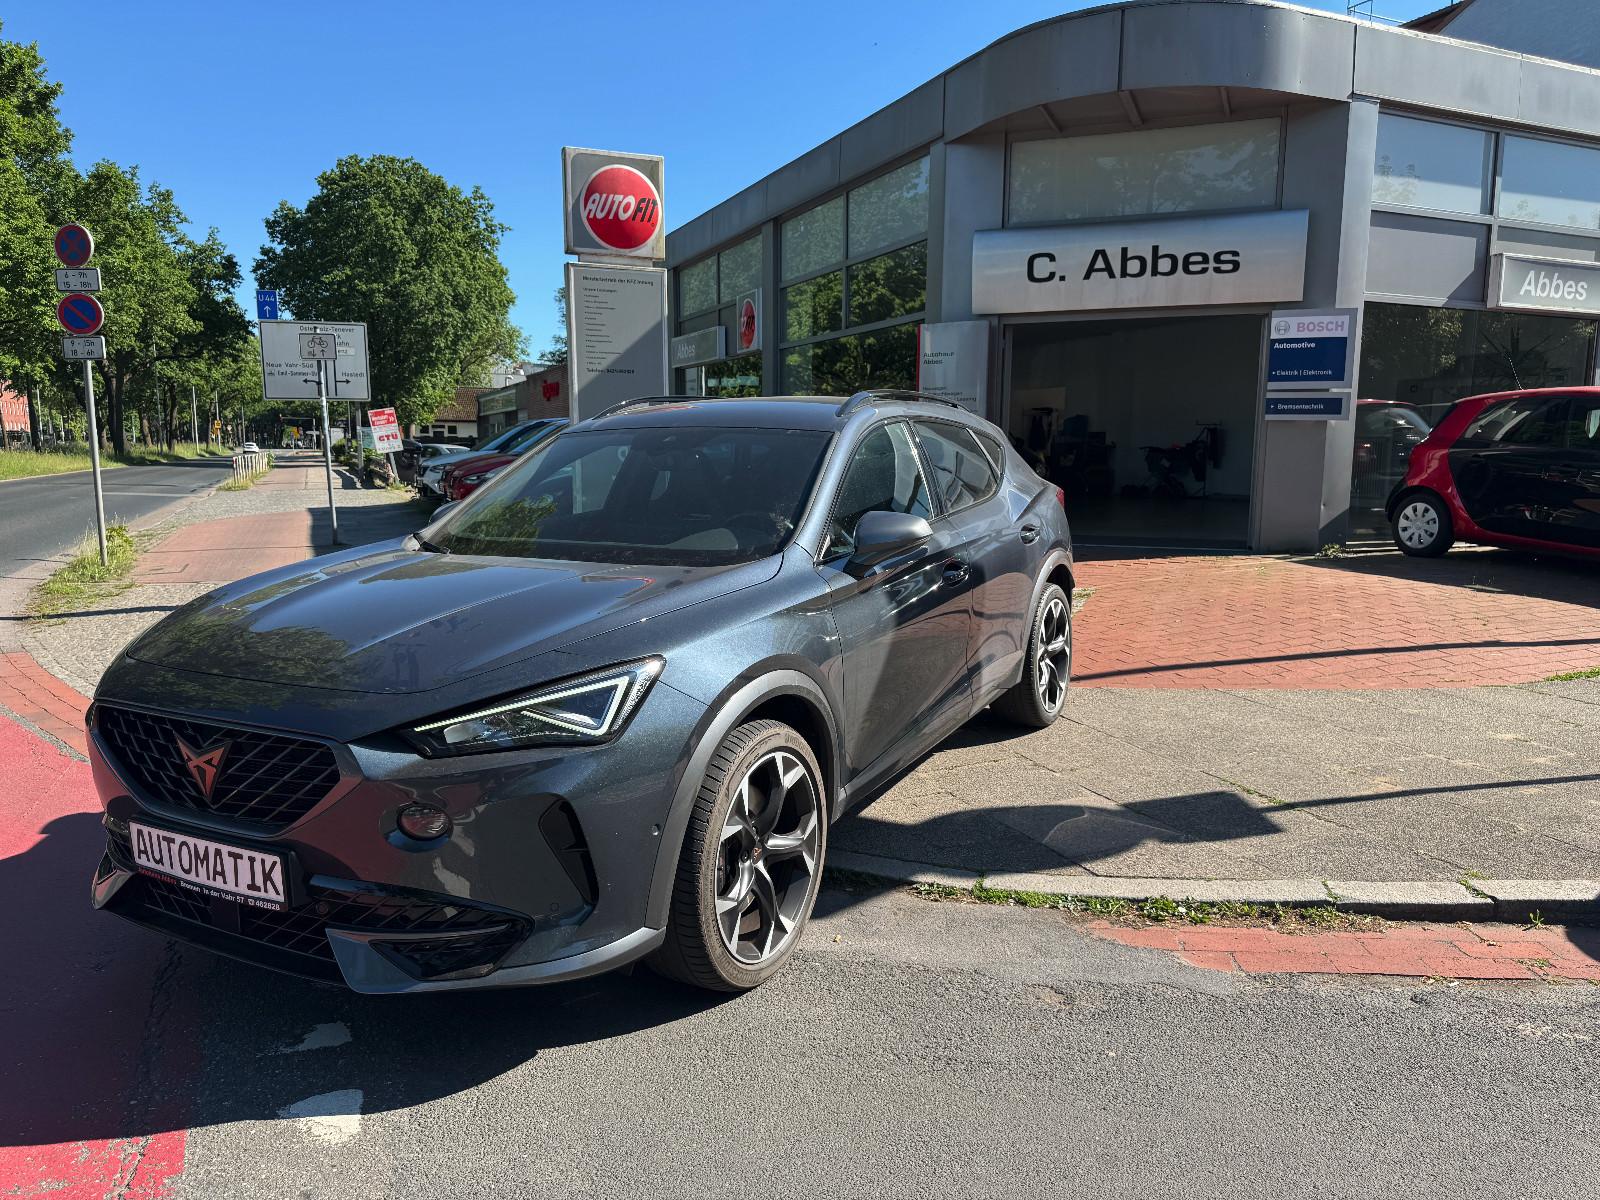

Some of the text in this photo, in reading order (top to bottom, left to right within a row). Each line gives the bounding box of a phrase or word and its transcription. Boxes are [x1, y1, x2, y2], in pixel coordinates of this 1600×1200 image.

[584, 192, 658, 223] AUTOFIT
[1026, 244, 1241, 283] C. Abbes
[64, 271, 69, 279] 6
[63, 281, 71, 289] 15
[80, 281, 92, 289] 18h
[1519, 269, 1588, 301] Abbes
[258, 294, 275, 302] U 44
[1296, 321, 1345, 333] BOSCH
[677, 343, 696, 359] Abbes
[1273, 341, 1316, 349] Automotive
[70, 349, 78, 357] 18
[86, 349, 95, 357] 6h
[284, 361, 314, 369] Vahr-Süd
[136, 828, 281, 896] AUTOMATIK
[180, 880, 201, 893] Bremen
[220, 891, 235, 902] Vahr
[255, 901, 280, 911] 462828
